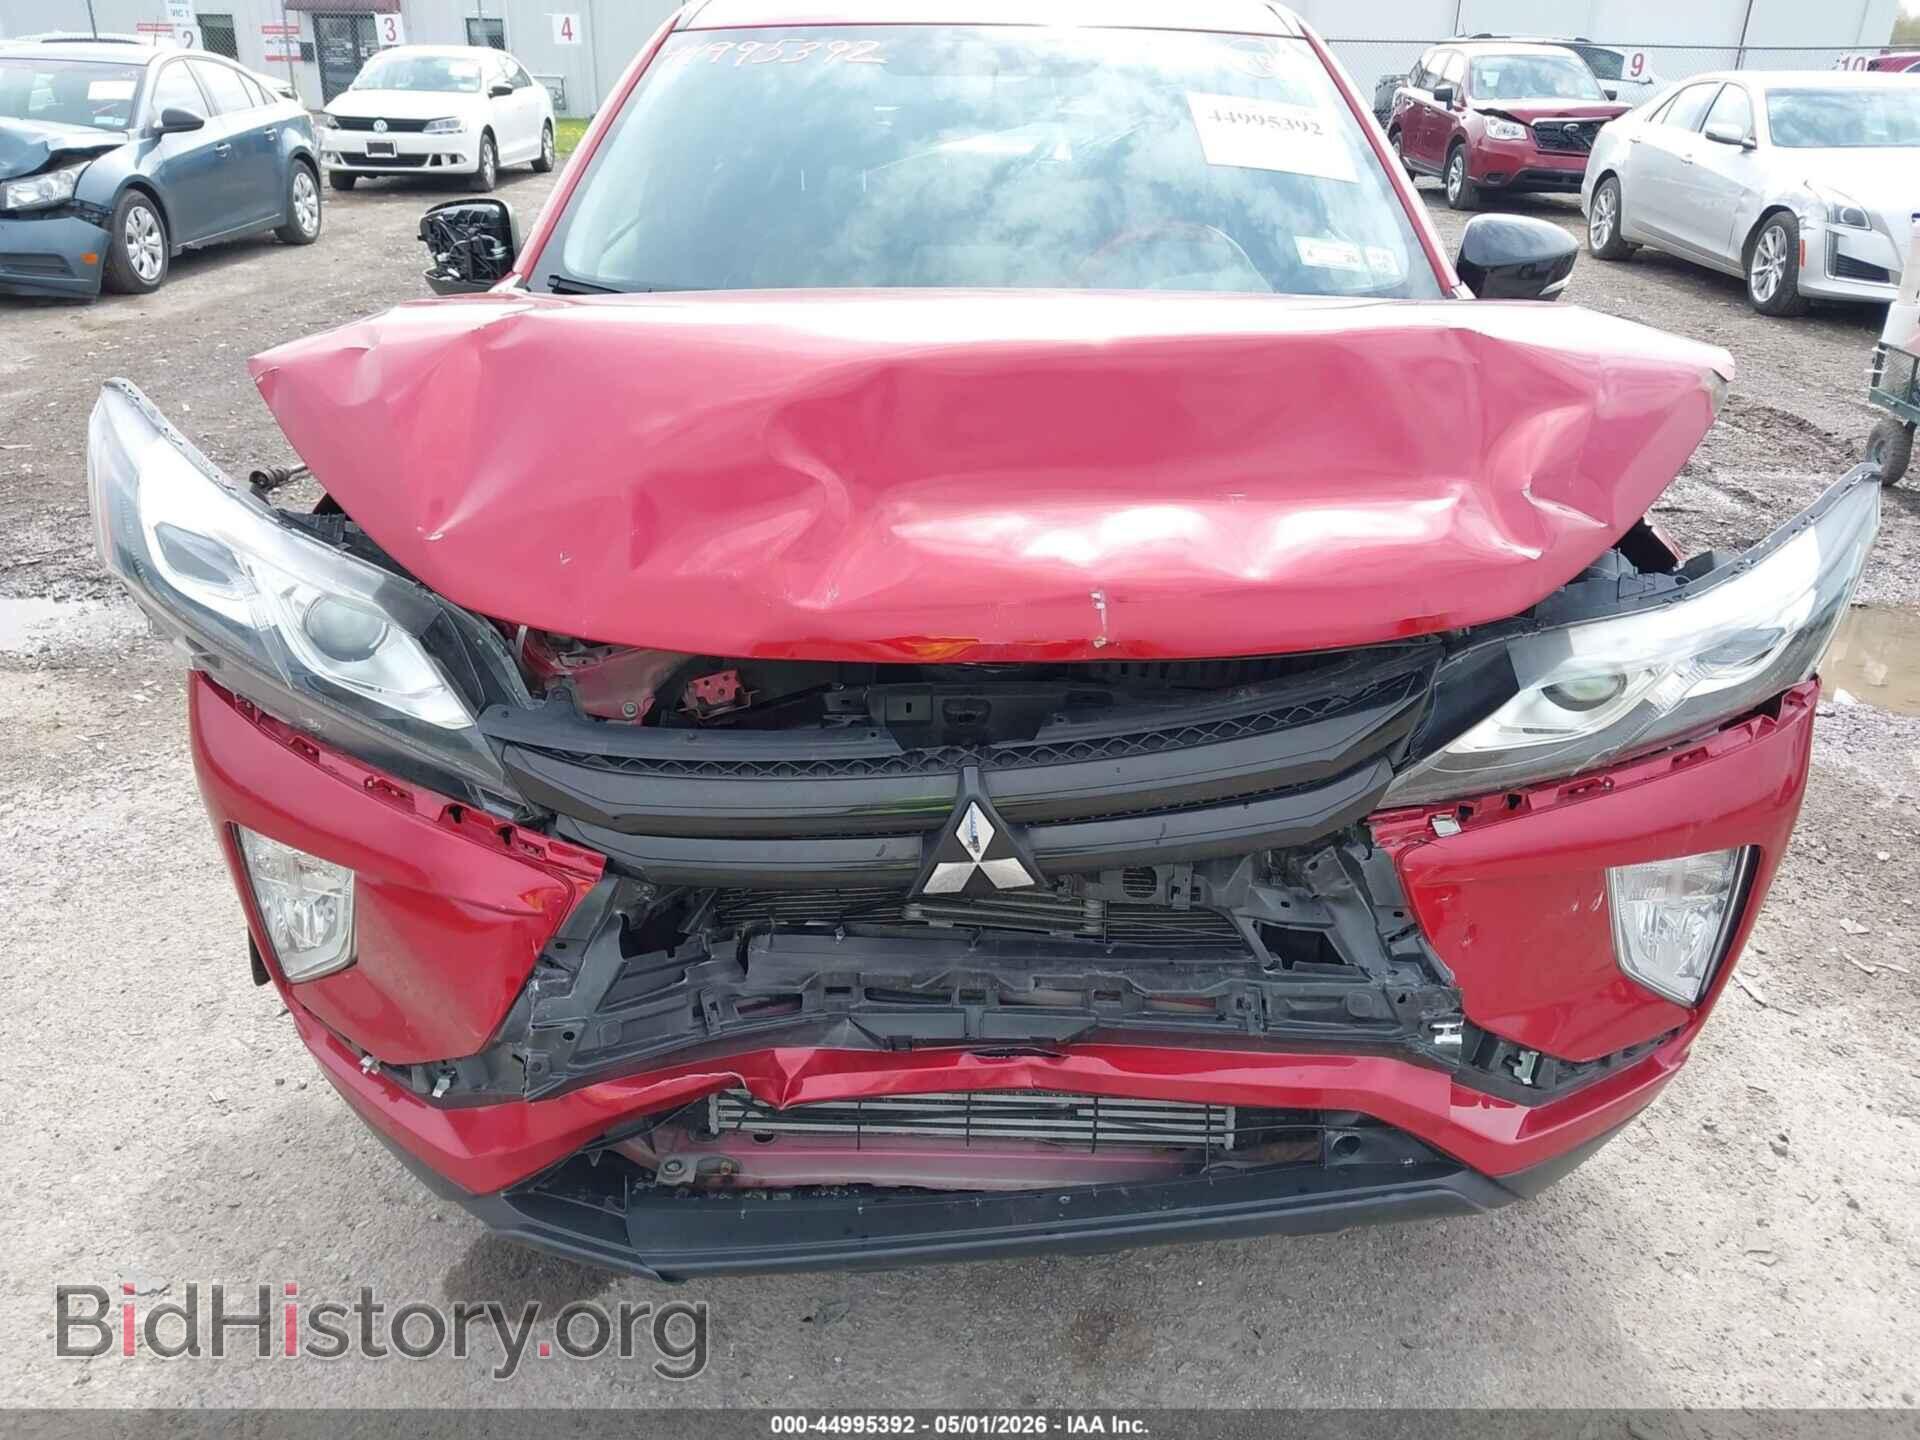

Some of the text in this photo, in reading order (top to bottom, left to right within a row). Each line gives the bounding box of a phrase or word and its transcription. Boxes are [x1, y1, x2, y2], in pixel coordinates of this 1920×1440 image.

[182, 30, 194, 49] 2
[383, 17, 397, 42] 3
[561, 17, 574, 41] 4
[1630, 53, 1645, 78] 9
[1841, 56, 1868, 72] 10
[1207, 109, 1326, 137] 44995392
